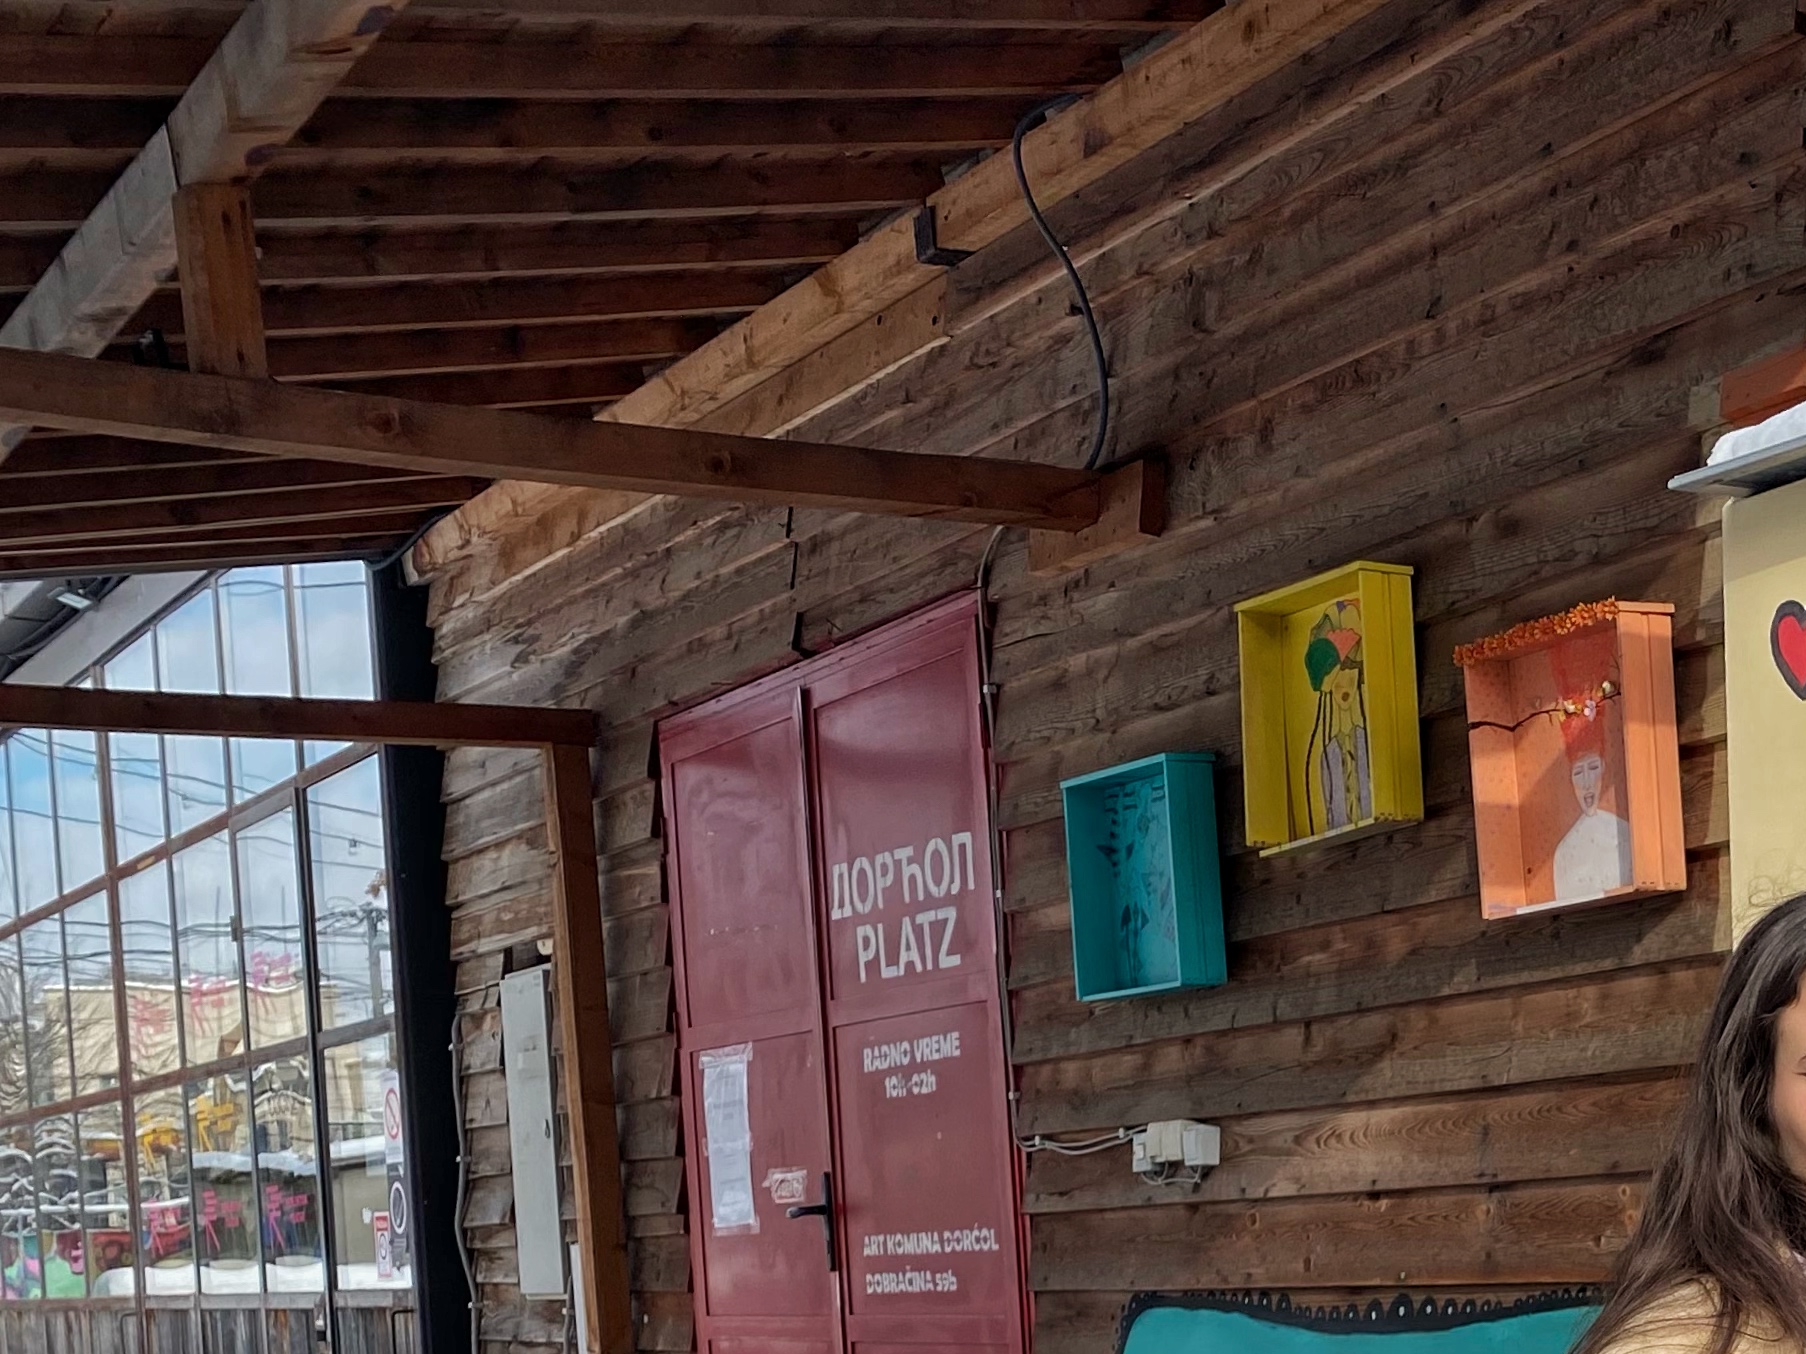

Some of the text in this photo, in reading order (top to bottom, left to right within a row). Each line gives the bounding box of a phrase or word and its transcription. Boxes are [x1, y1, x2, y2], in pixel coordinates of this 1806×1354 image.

[831, 831, 975, 921] ДОРЋОЛ
[856, 906, 961, 984] PLATZ
[863, 1031, 961, 1073] RADNO VREME
[863, 1222, 999, 1257] ART KOMUNA DORĆOL
[865, 1265, 934, 1295] DOBRAČINA
